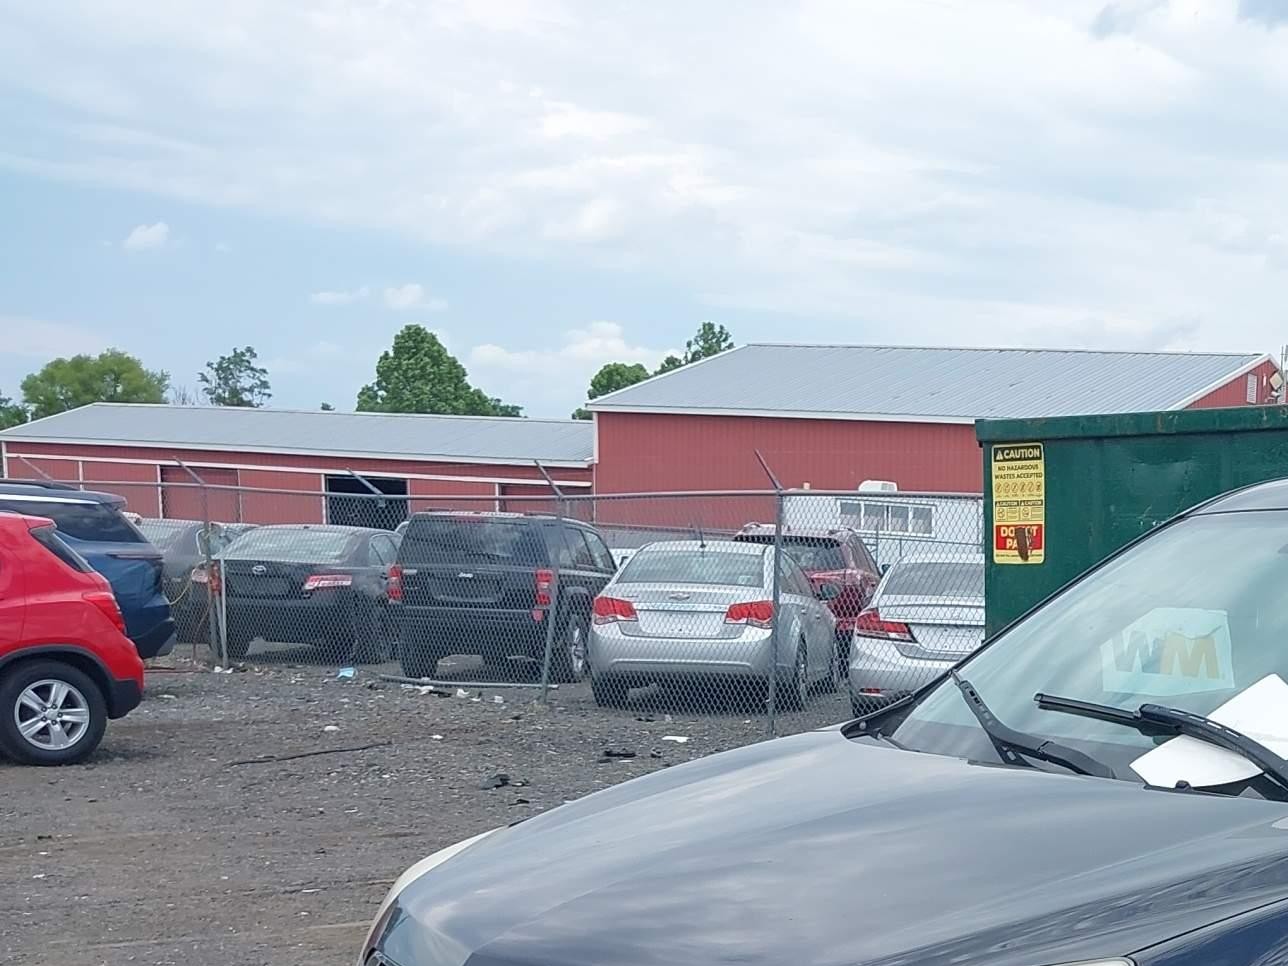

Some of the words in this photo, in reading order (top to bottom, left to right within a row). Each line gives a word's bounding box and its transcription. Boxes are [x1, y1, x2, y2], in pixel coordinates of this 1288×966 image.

[1004, 448, 1040, 459] CAUTION
[1006, 463, 1039, 471] HAZARDOUS
[1016, 471, 1043, 479] ACCEPTED
[1000, 526, 1015, 537] DO
